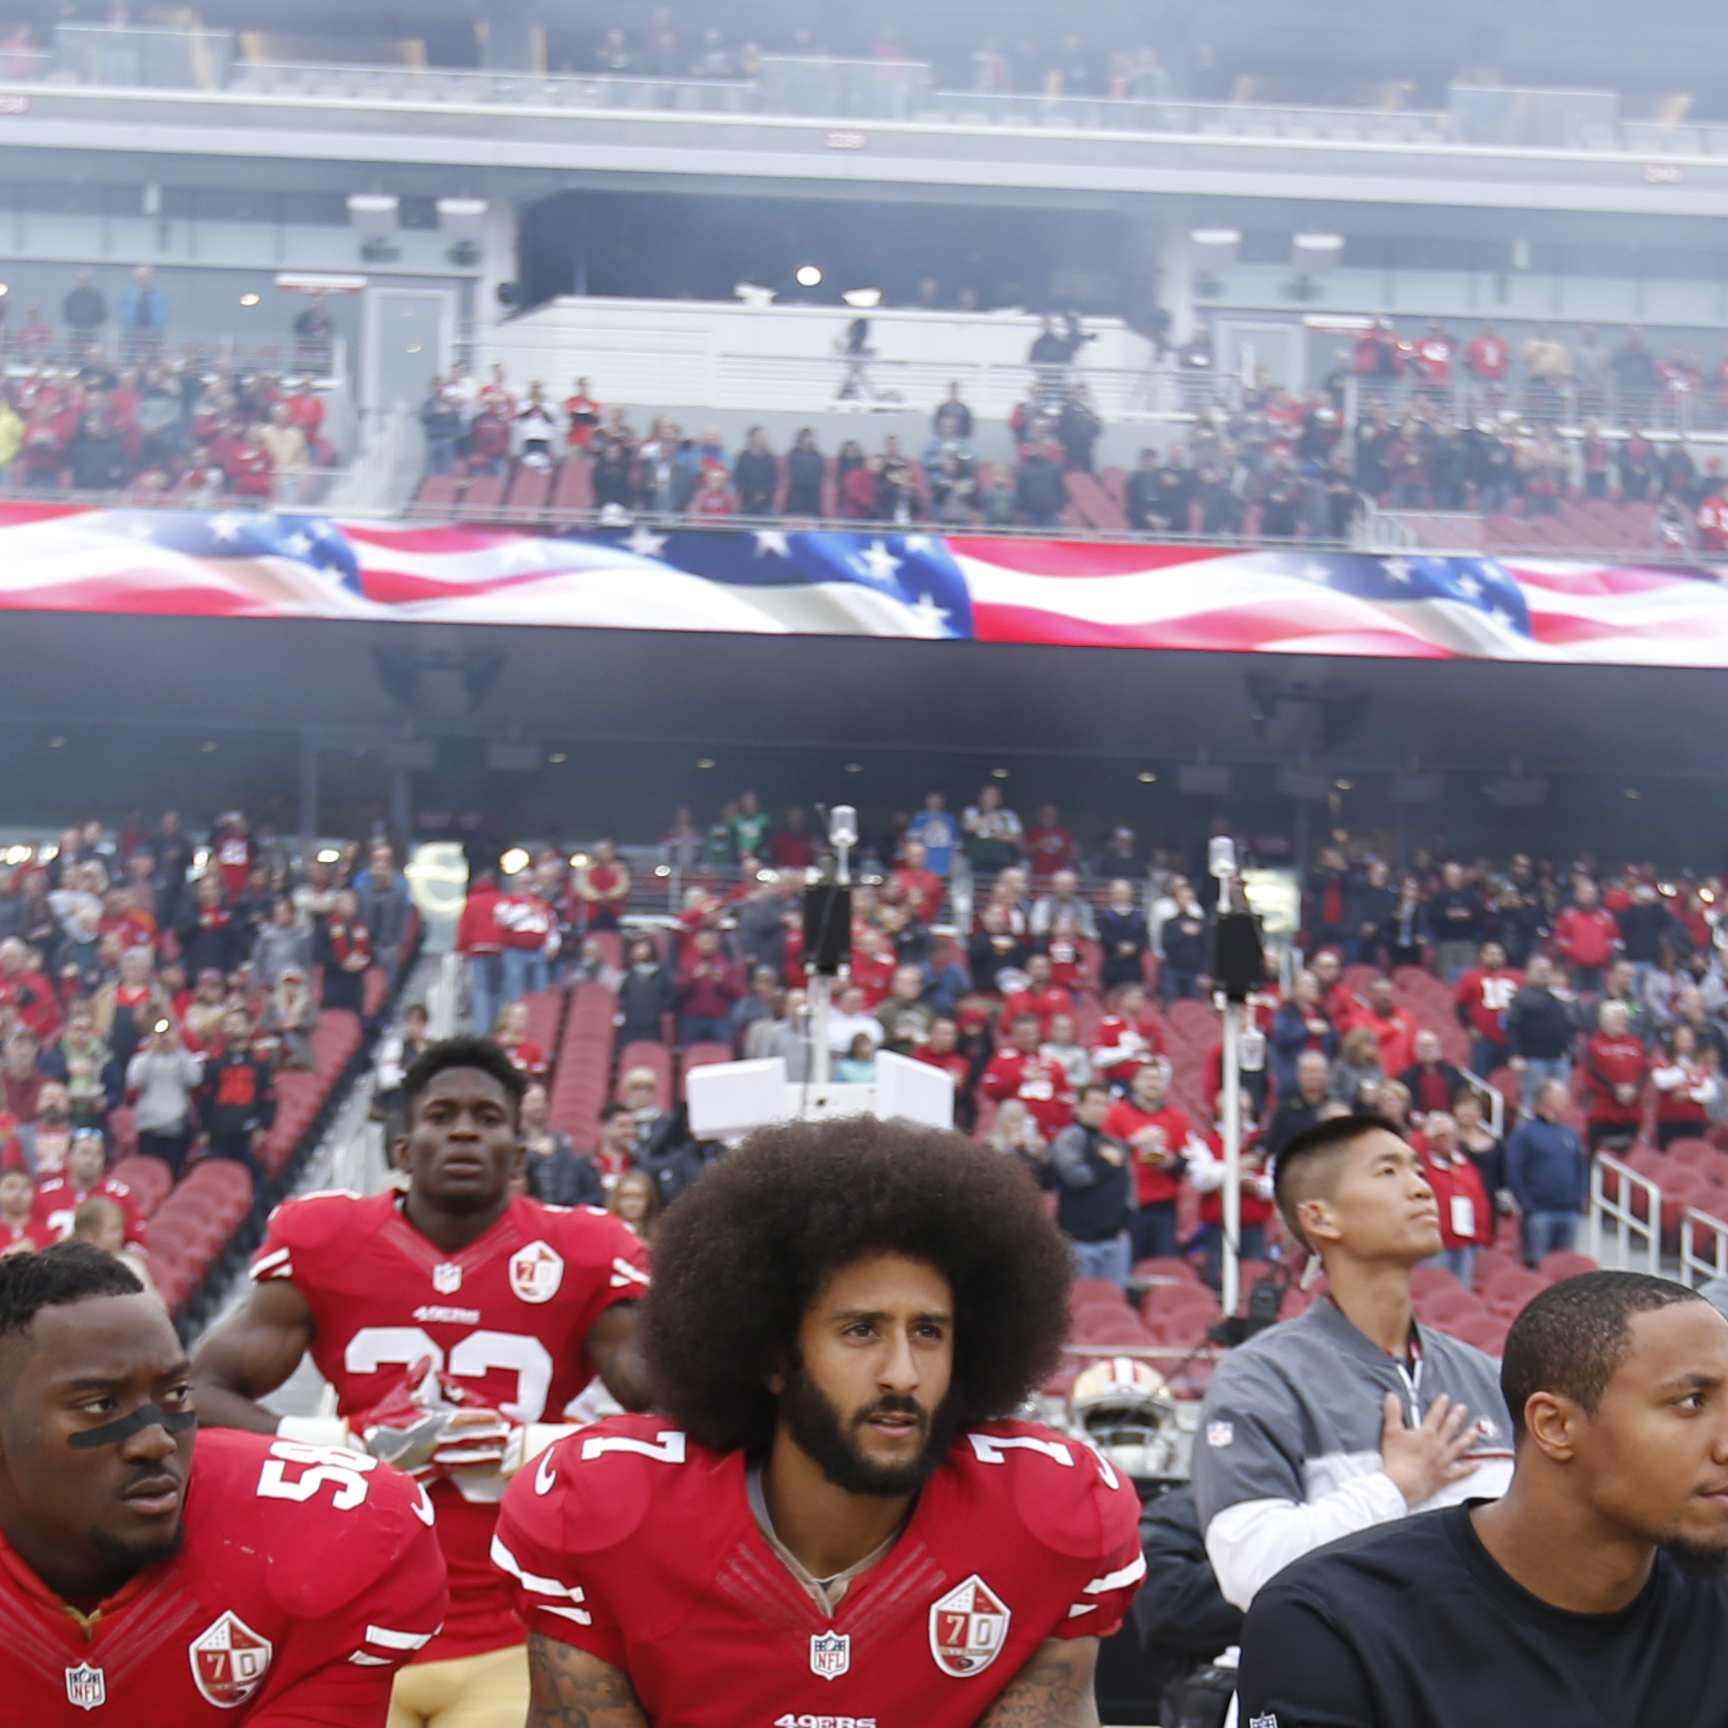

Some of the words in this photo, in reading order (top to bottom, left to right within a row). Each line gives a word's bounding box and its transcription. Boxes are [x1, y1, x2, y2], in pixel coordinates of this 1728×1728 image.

[945, 1615, 993, 1647] 70
[817, 1652, 844, 1671] NFL
[73, 1683, 100, 1700] NFL
